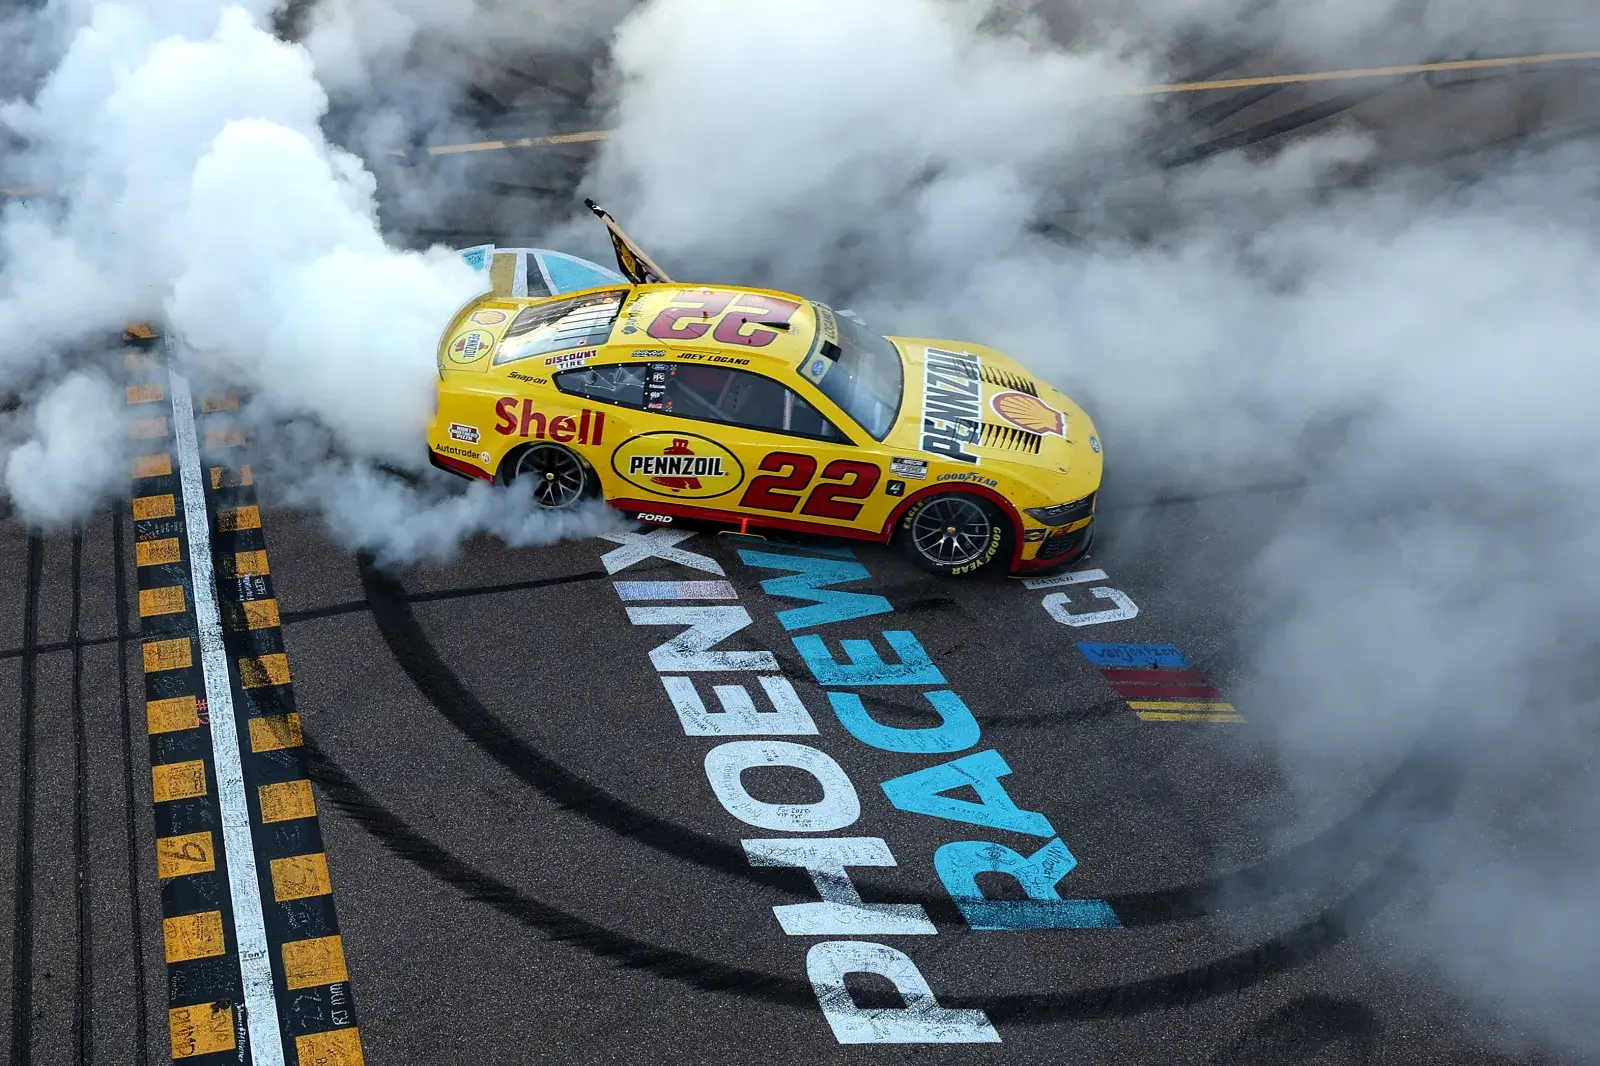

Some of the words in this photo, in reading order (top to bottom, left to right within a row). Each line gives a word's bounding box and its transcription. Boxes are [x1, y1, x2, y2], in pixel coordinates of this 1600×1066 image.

[647, 290, 801, 347] 22
[545, 349, 597, 365] DISCOUNT
[560, 360, 583, 369] TIRE
[677, 352, 706, 361] JOEY
[707, 355, 750, 366] LOGANO
[507, 371, 547, 385] Snap-on
[922, 346, 980, 465] PENNZOIL
[495, 396, 605, 446] Shell
[436, 443, 480, 459] Autotrader
[629, 455, 725, 477] PENNZOIL
[738, 450, 881, 521] 22
[637, 512, 672, 523] FORD
[903, 499, 926, 530] EAGLE
[737, 540, 1124, 930] RACEW
[600, 527, 1002, 1045] PHOENIX
